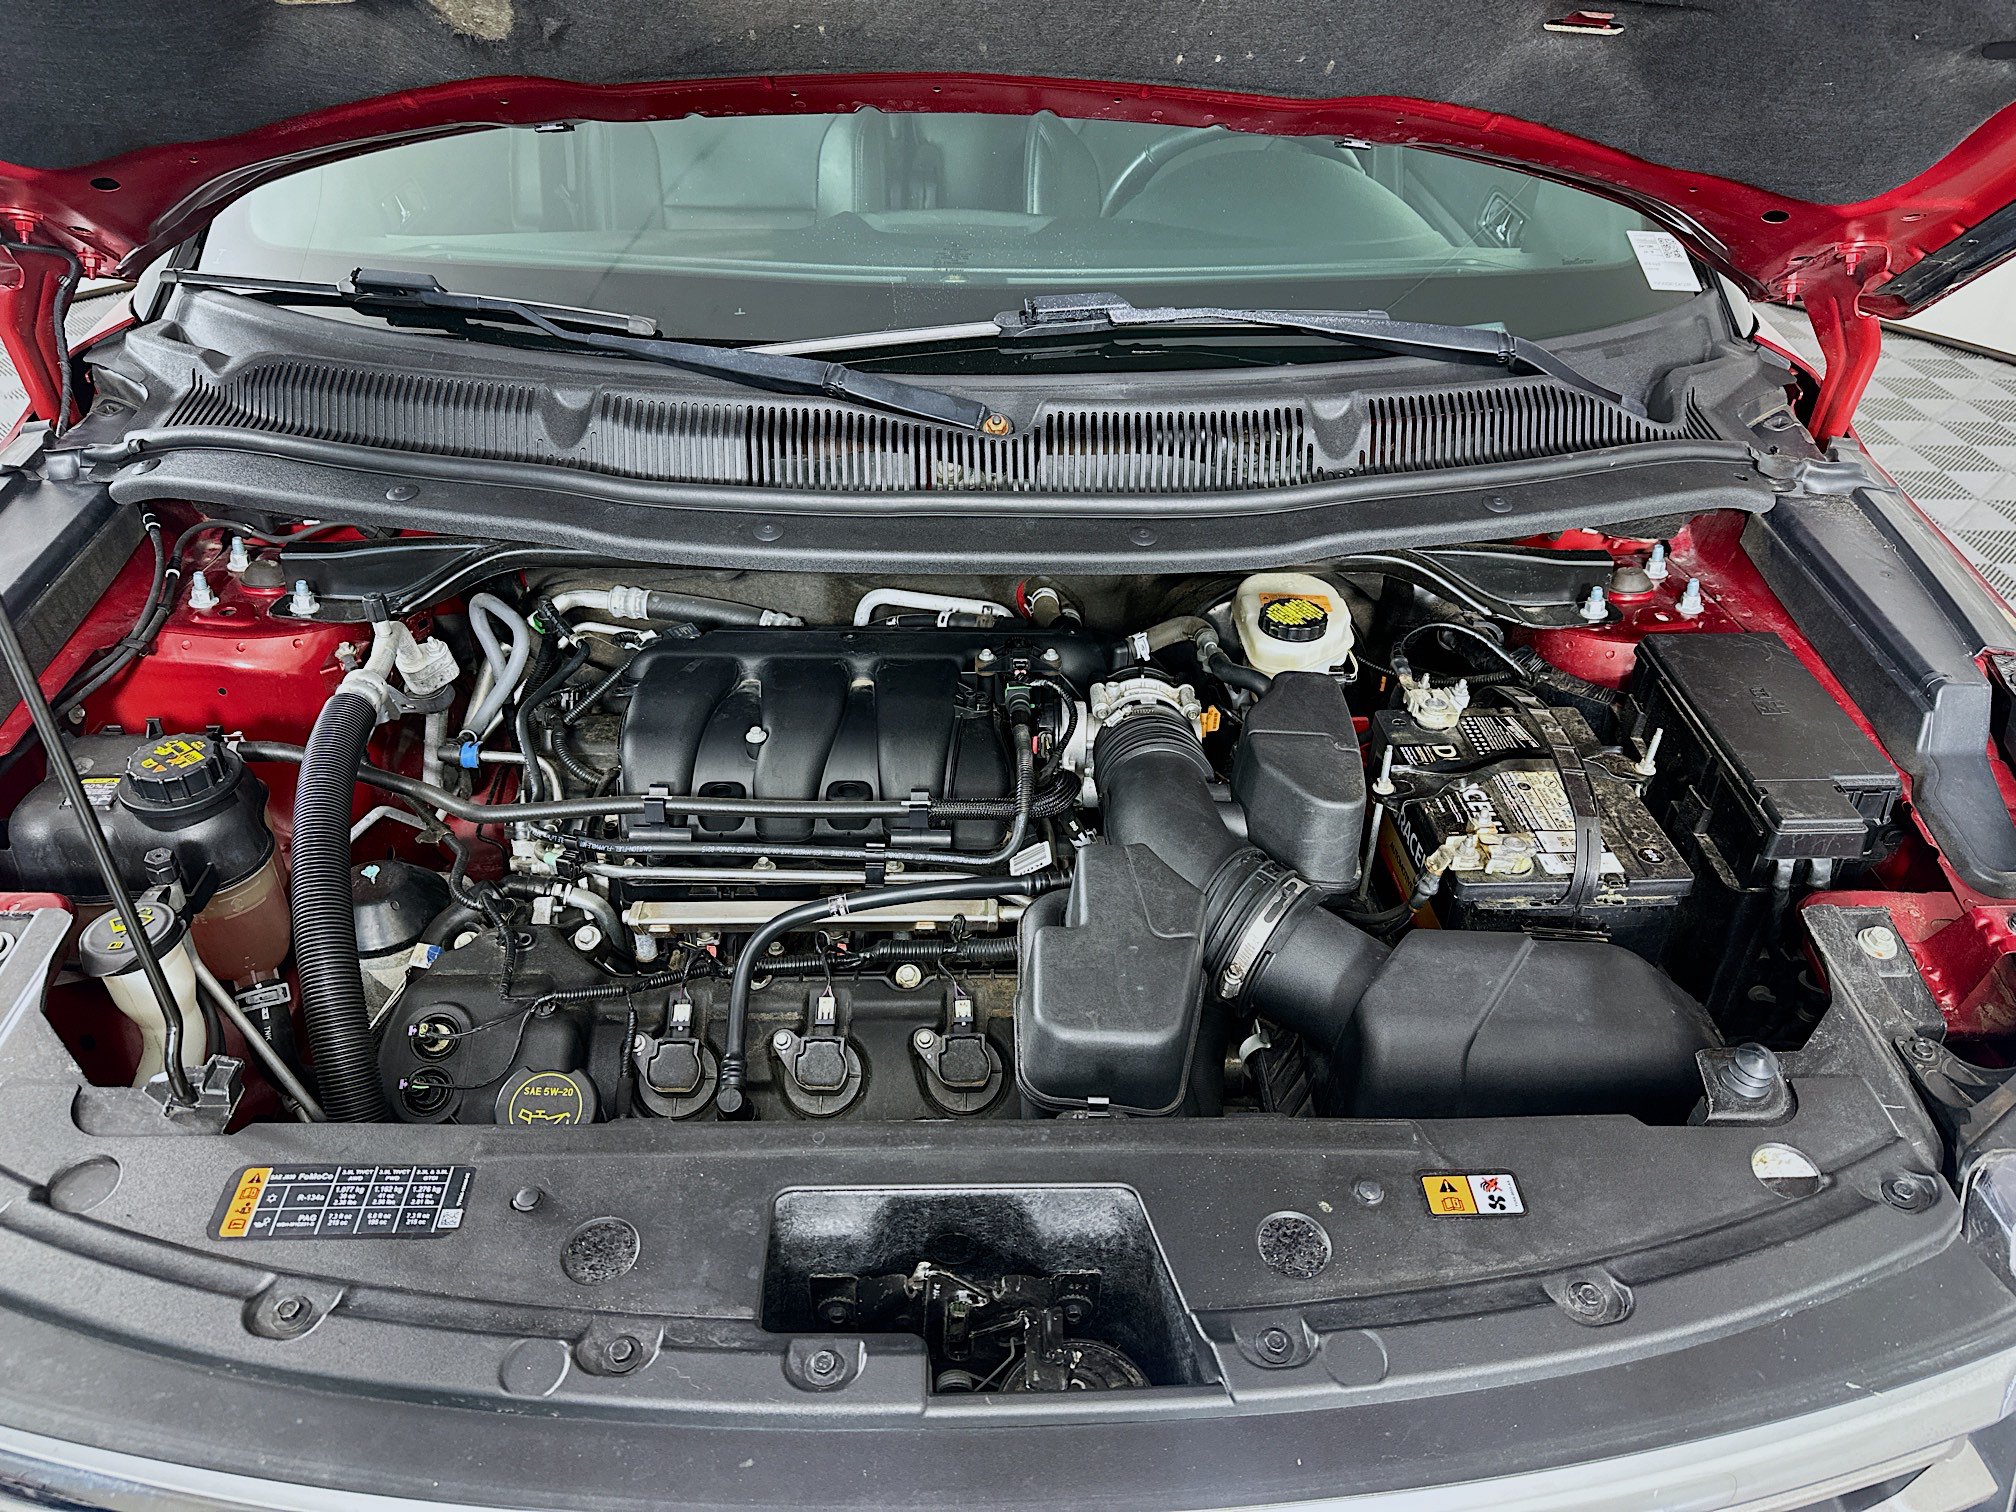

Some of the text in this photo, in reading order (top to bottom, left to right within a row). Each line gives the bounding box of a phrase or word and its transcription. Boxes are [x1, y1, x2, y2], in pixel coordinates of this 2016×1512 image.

[263, 1025, 273, 1041] TNK
[523, 1086, 574, 1097] SAE 5W-20
[298, 1172, 334, 1181] FoMoCo
[355, 1186, 365, 1195] kg
[394, 1186, 404, 1194] kg
[432, 1186, 442, 1194] kg
[296, 1193, 325, 1202] R-134a
[297, 1213, 317, 1222] PAG
